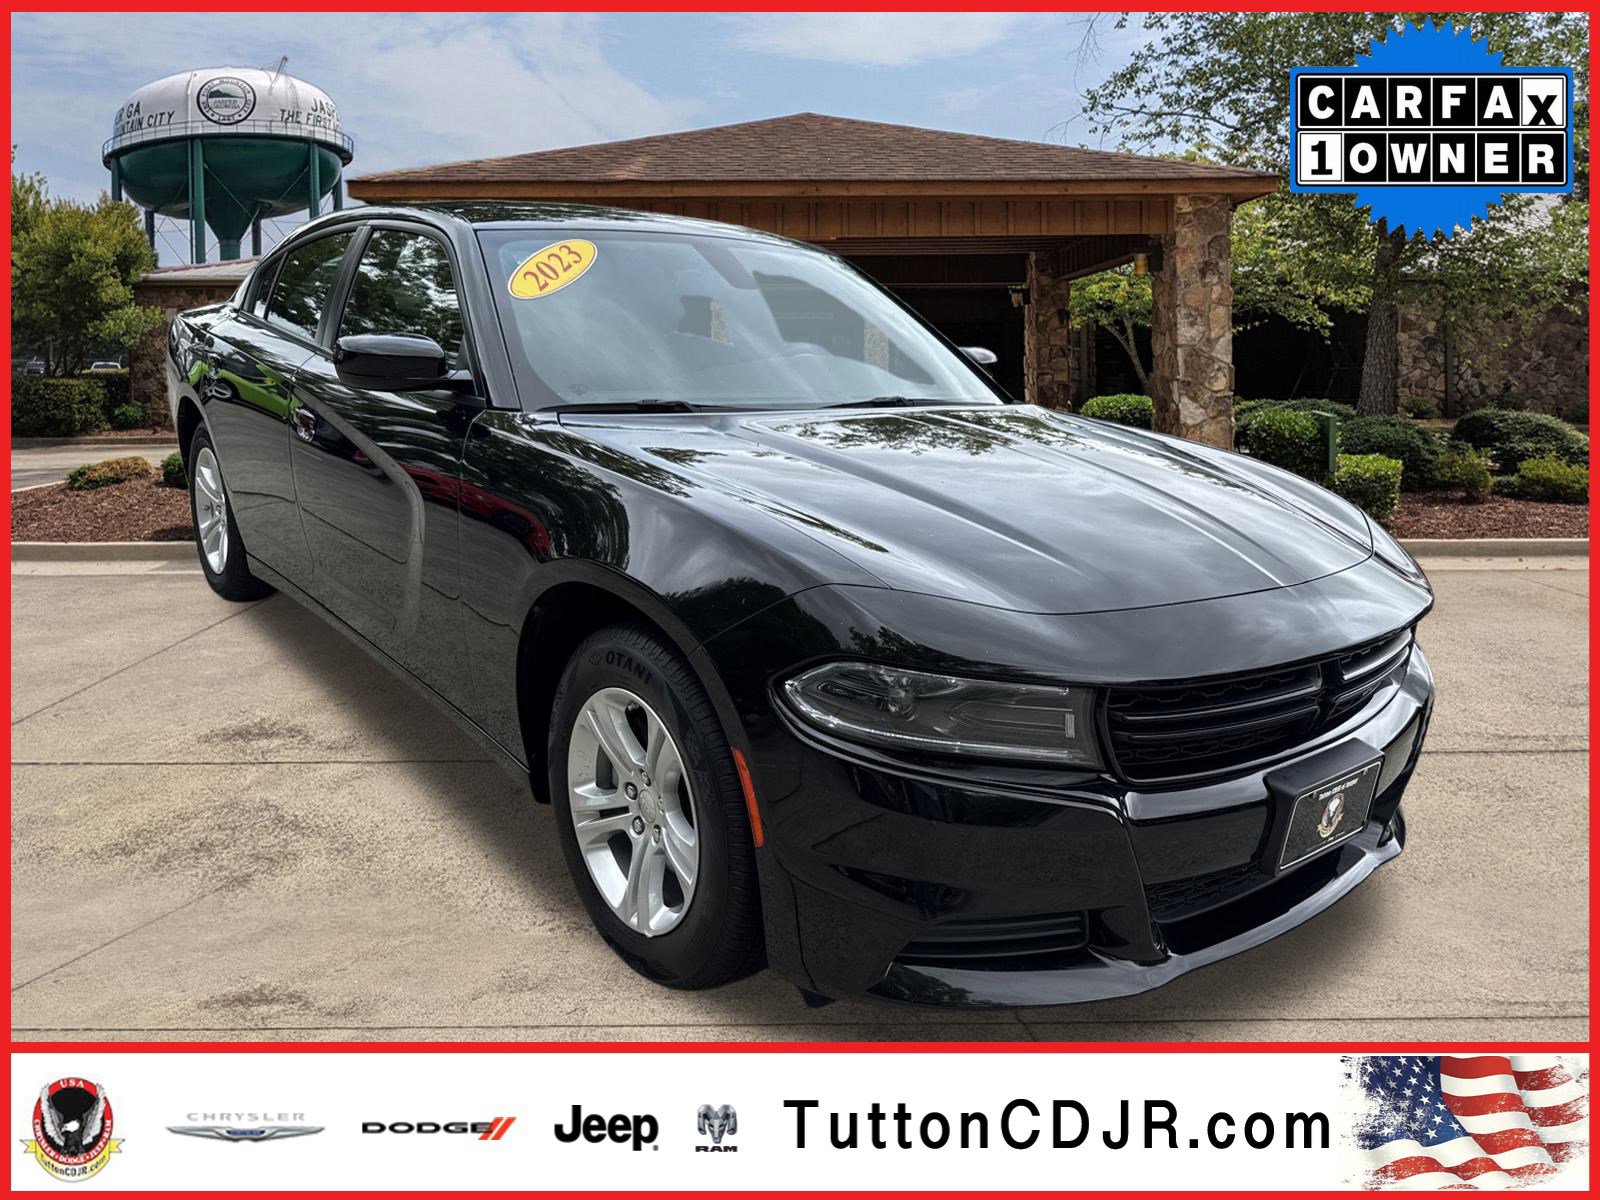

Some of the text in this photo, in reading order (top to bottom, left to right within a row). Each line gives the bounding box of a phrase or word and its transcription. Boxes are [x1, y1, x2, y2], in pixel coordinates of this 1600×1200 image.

[126, 101, 141, 119] GA
[147, 110, 175, 127] CITY
[280, 108, 302, 123] THE
[306, 112, 332, 129] FIRST
[523, 245, 582, 291] 2023
[606, 650, 653, 685] OTANI
